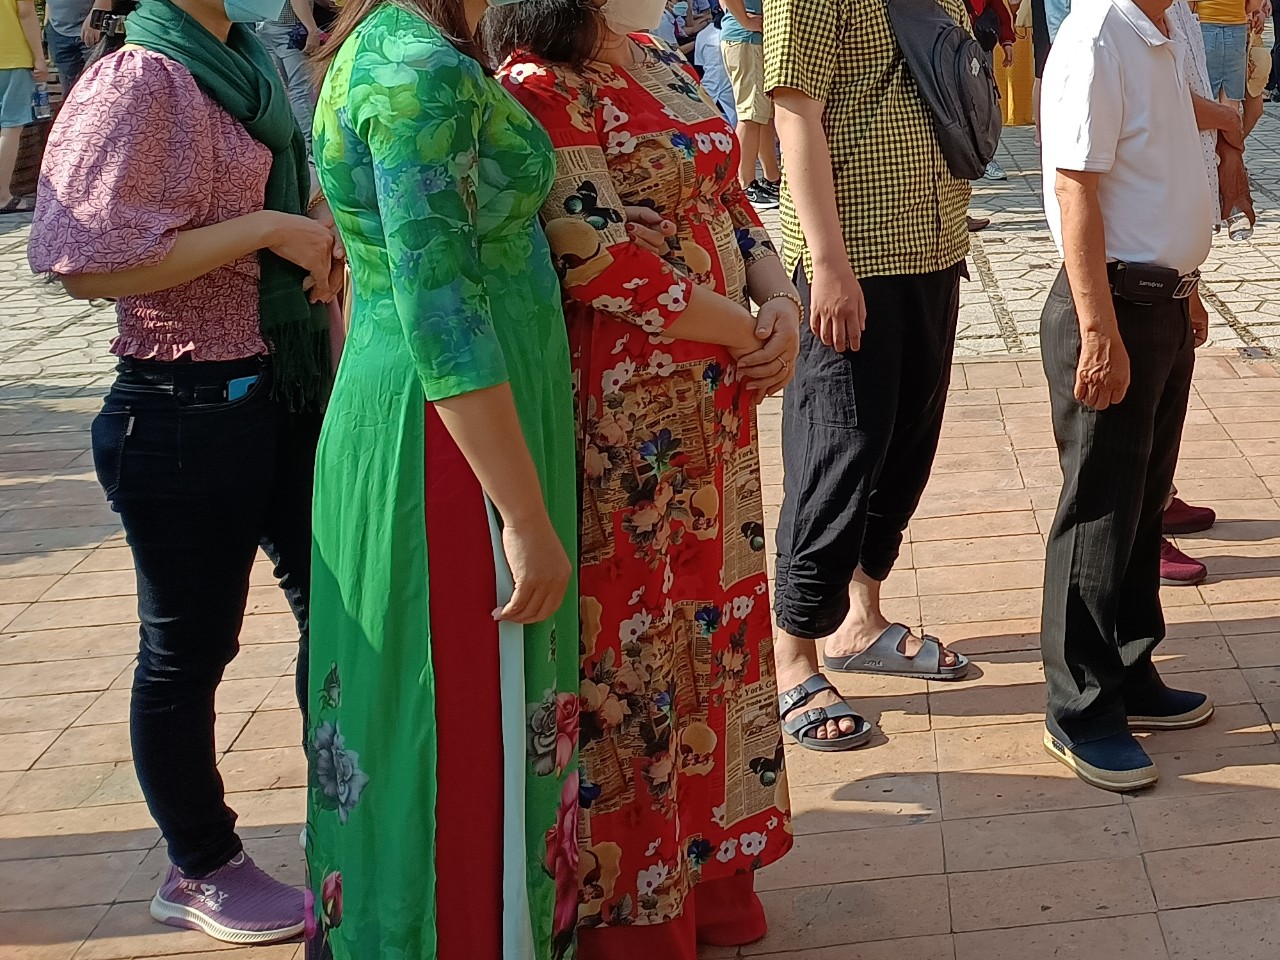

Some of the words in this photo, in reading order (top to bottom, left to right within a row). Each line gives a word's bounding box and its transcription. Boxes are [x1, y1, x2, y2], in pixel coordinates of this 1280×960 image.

[1138, 280, 1164, 289] Samsonite
[737, 447, 754, 461] York
[744, 683, 764, 697] York
